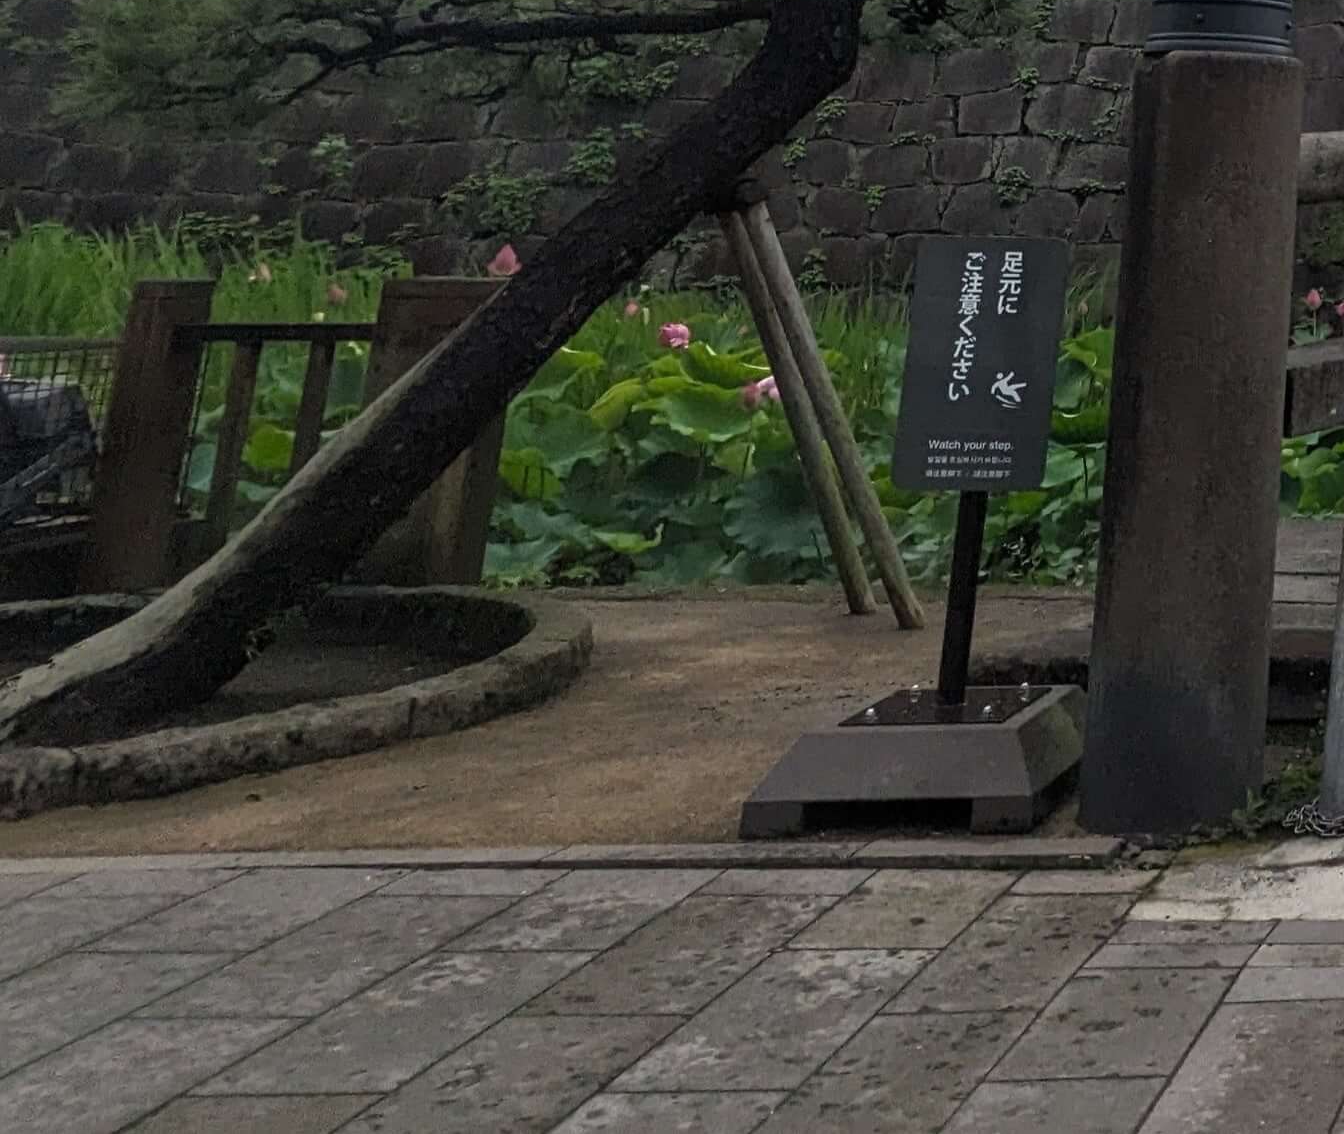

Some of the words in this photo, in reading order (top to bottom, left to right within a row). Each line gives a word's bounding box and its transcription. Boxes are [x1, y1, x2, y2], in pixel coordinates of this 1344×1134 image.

[997, 251, 1023, 314] 足元に
[949, 252, 987, 401] ご注意ください
[928, 440, 961, 450] Watch
[963, 441, 986, 452] your
